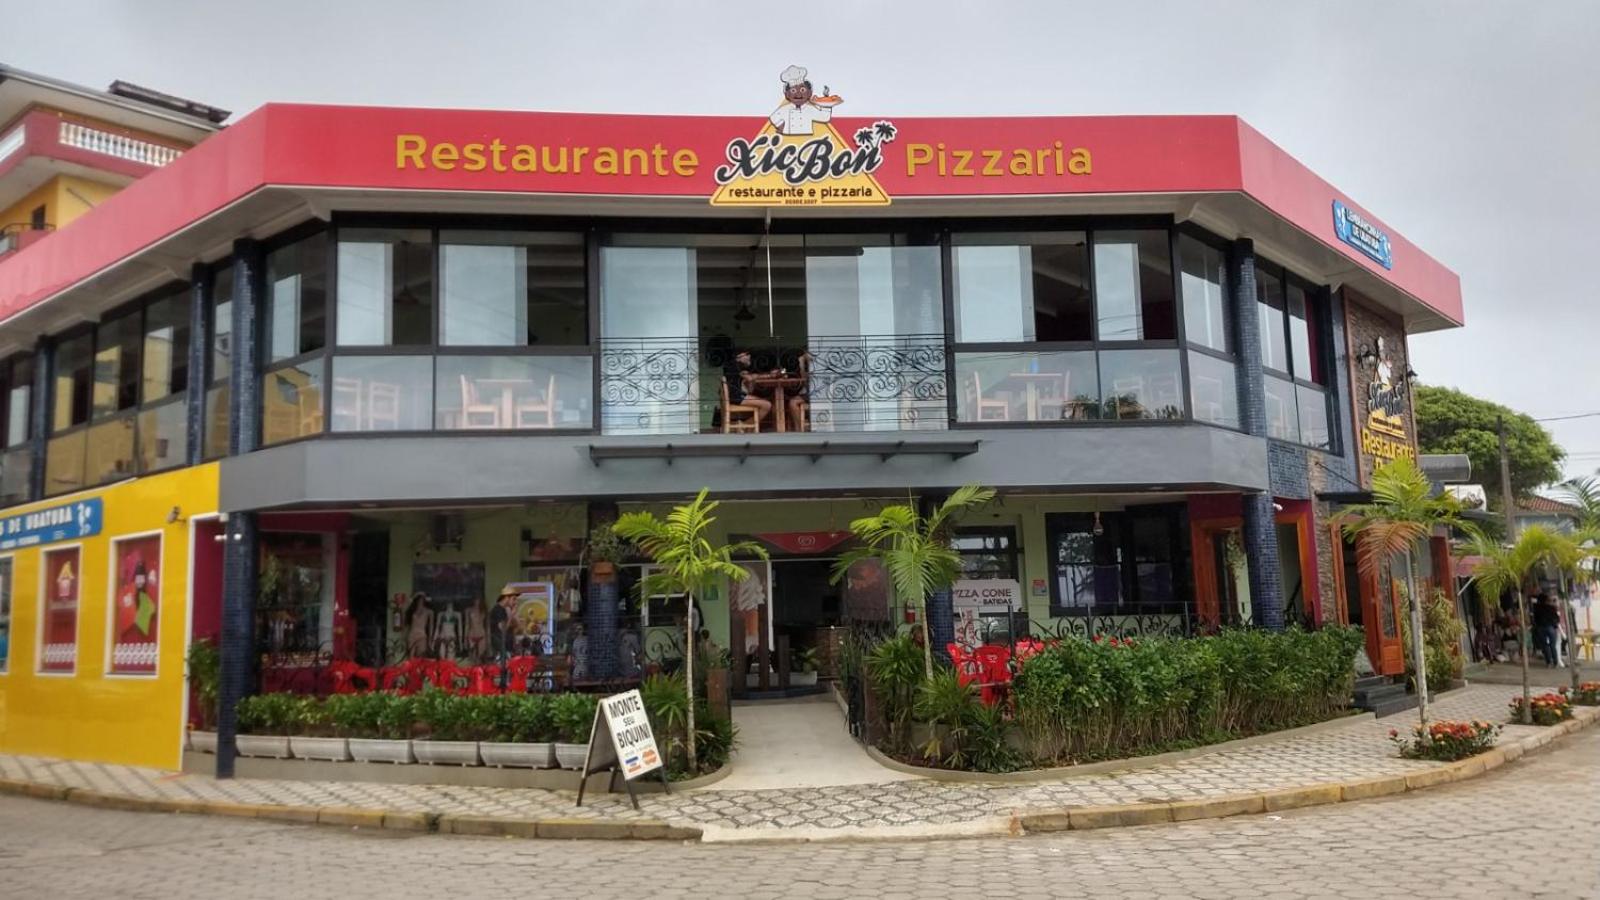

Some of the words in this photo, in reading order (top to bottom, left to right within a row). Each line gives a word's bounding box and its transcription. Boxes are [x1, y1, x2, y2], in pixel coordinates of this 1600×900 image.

[396, 134, 699, 176] Restaurante
[717, 135, 881, 183] XicBon
[906, 141, 1092, 176] Pizzaria
[729, 186, 804, 198] restaurante
[808, 188, 816, 197] e
[821, 186, 872, 199] pizzaria
[8, 517, 21, 534] DE
[26, 506, 72, 530] UBATUBA
[982, 588, 1012, 597] CONE
[608, 695, 641, 719] MONTE
[617, 722, 651, 748] BIQUINI
